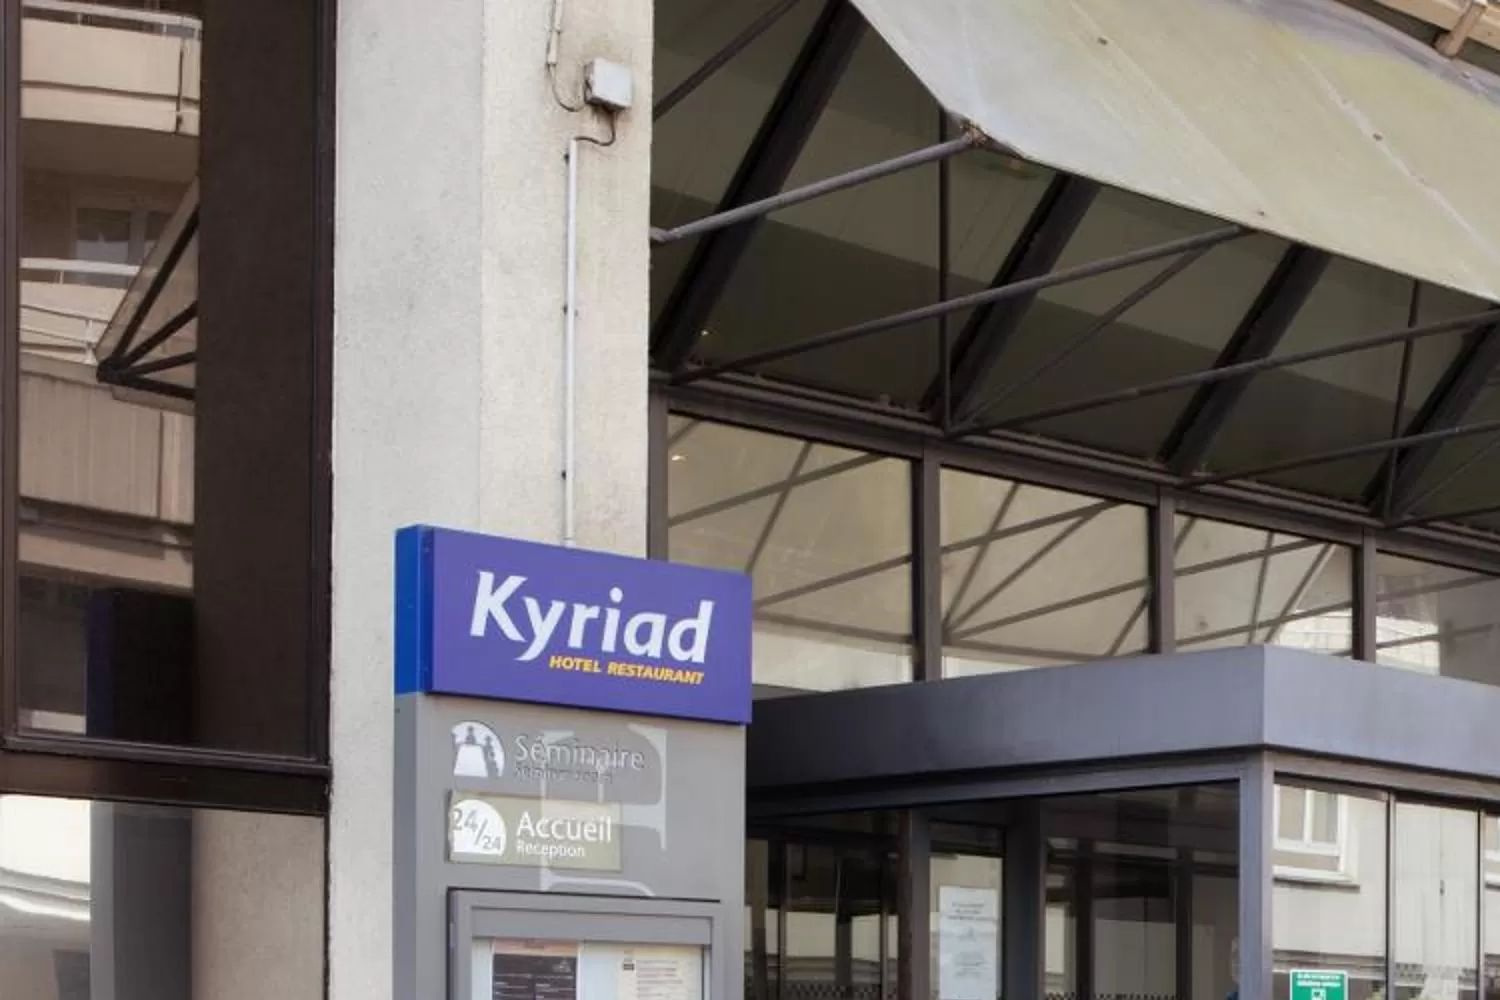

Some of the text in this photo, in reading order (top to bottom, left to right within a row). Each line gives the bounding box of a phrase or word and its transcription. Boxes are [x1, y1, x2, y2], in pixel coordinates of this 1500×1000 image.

[469, 570, 716, 664] Kyriad
[549, 655, 706, 685] HOTEL RESTAURANT
[514, 733, 645, 771] Séminaire
[516, 811, 613, 843] Accueil
